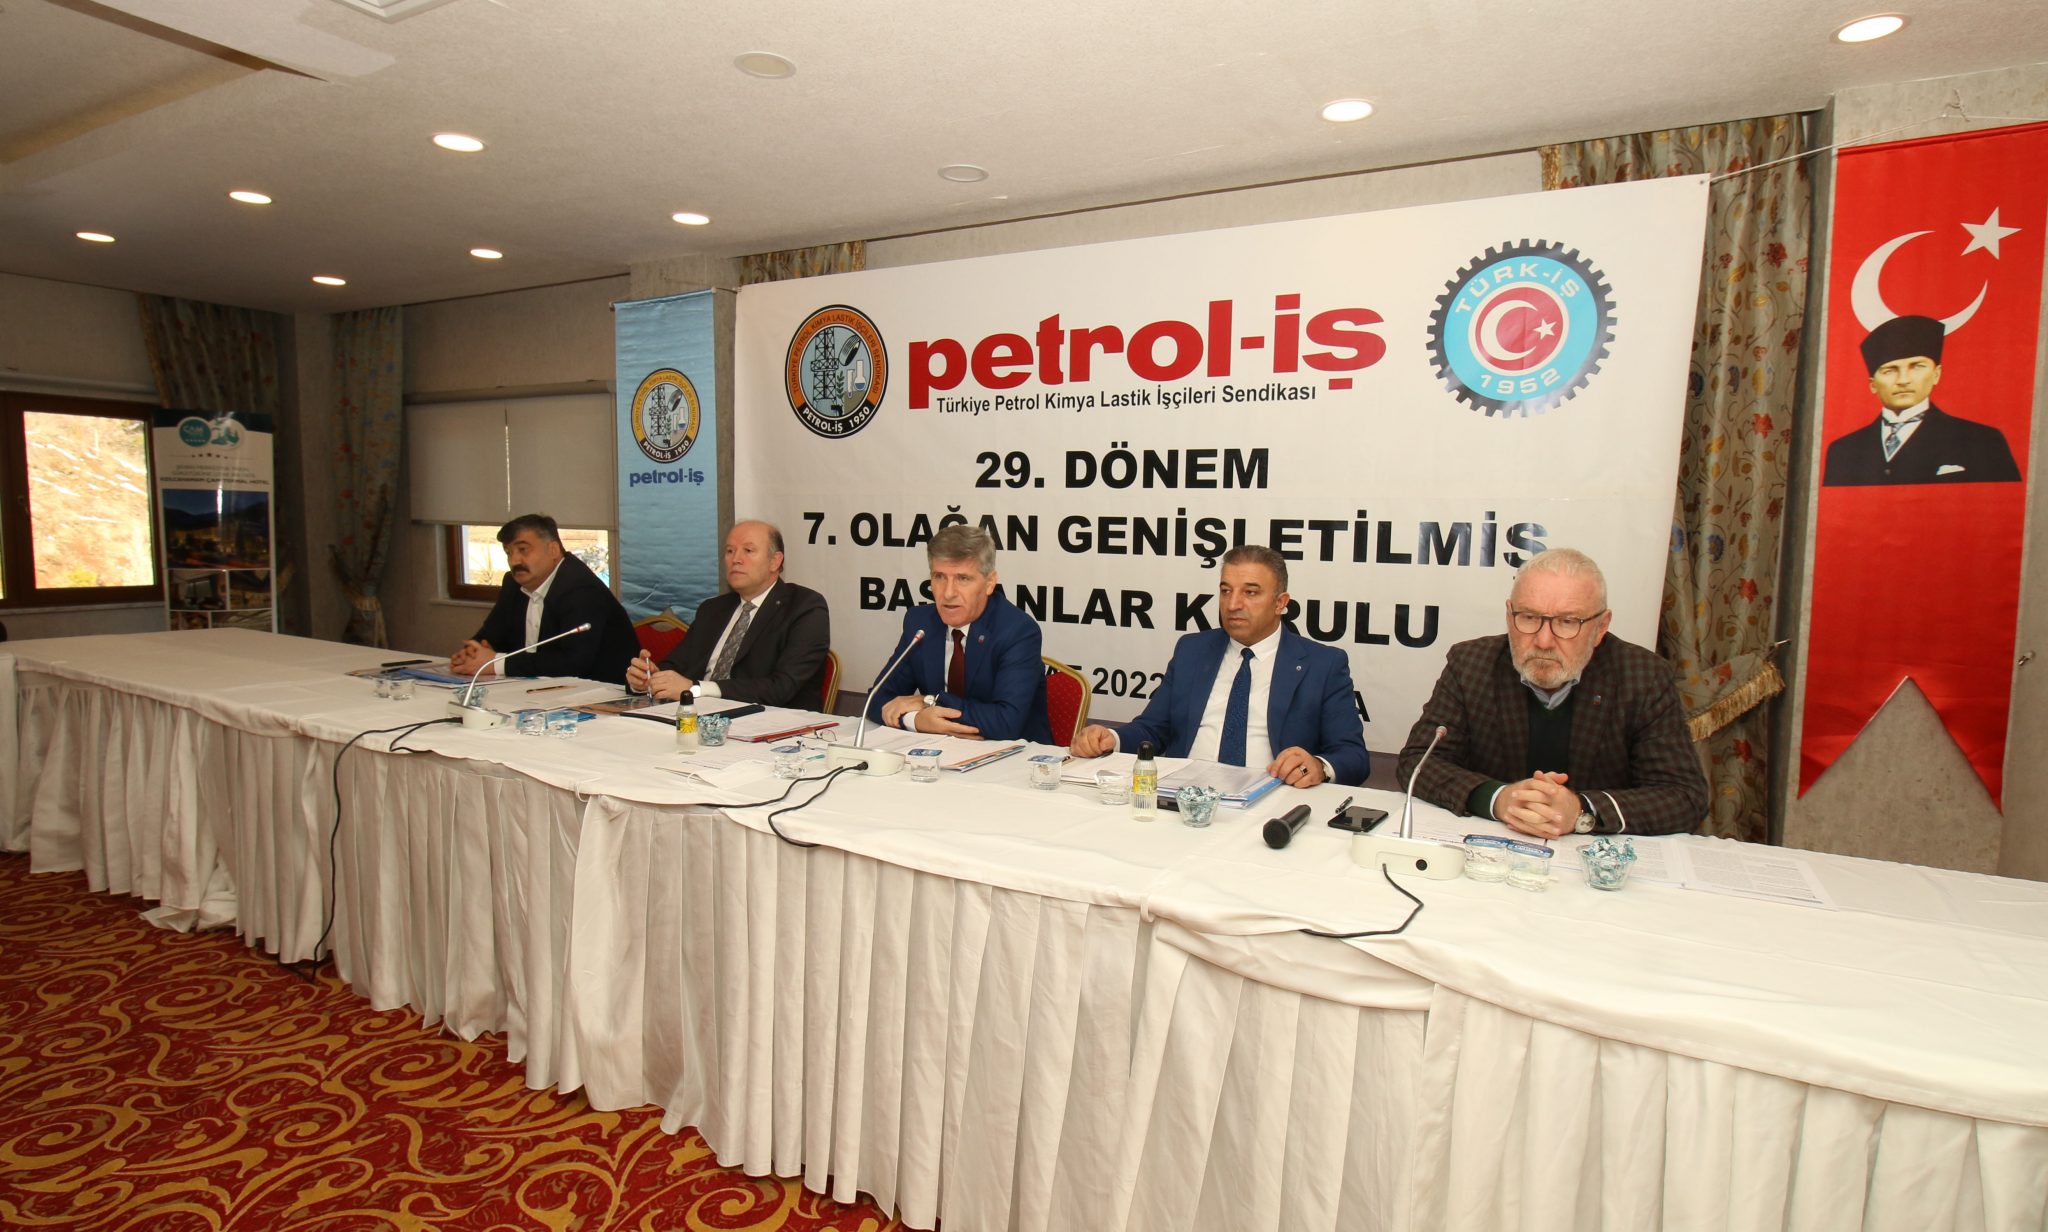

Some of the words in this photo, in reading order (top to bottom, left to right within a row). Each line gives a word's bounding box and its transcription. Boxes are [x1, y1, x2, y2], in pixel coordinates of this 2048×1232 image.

[1454, 262, 1581, 314] TÜRK-İŞ
[908, 293, 1387, 409] petrol-iş
[1480, 367, 1562, 394] 1952
[936, 397, 990, 416] Türkiye
[994, 395, 1040, 412] Petrol
[1044, 393, 1095, 411] Kimya
[1100, 389, 1151, 407] Lastik
[1156, 386, 1216, 410] İşçileri
[1221, 383, 1317, 404] Sendikası
[802, 407, 843, 434] PETROL-İŞ
[849, 406, 870, 428] 1950
[675, 440, 689, 456] 1950
[629, 467, 705, 488] petrol-iş
[975, 451, 1045, 489] 29.
[1065, 441, 1269, 489] DÖNEM
[803, 512, 837, 545] 7.
[860, 577, 1155, 629] BANLAR
[1175, 593, 1440, 648] KULU
